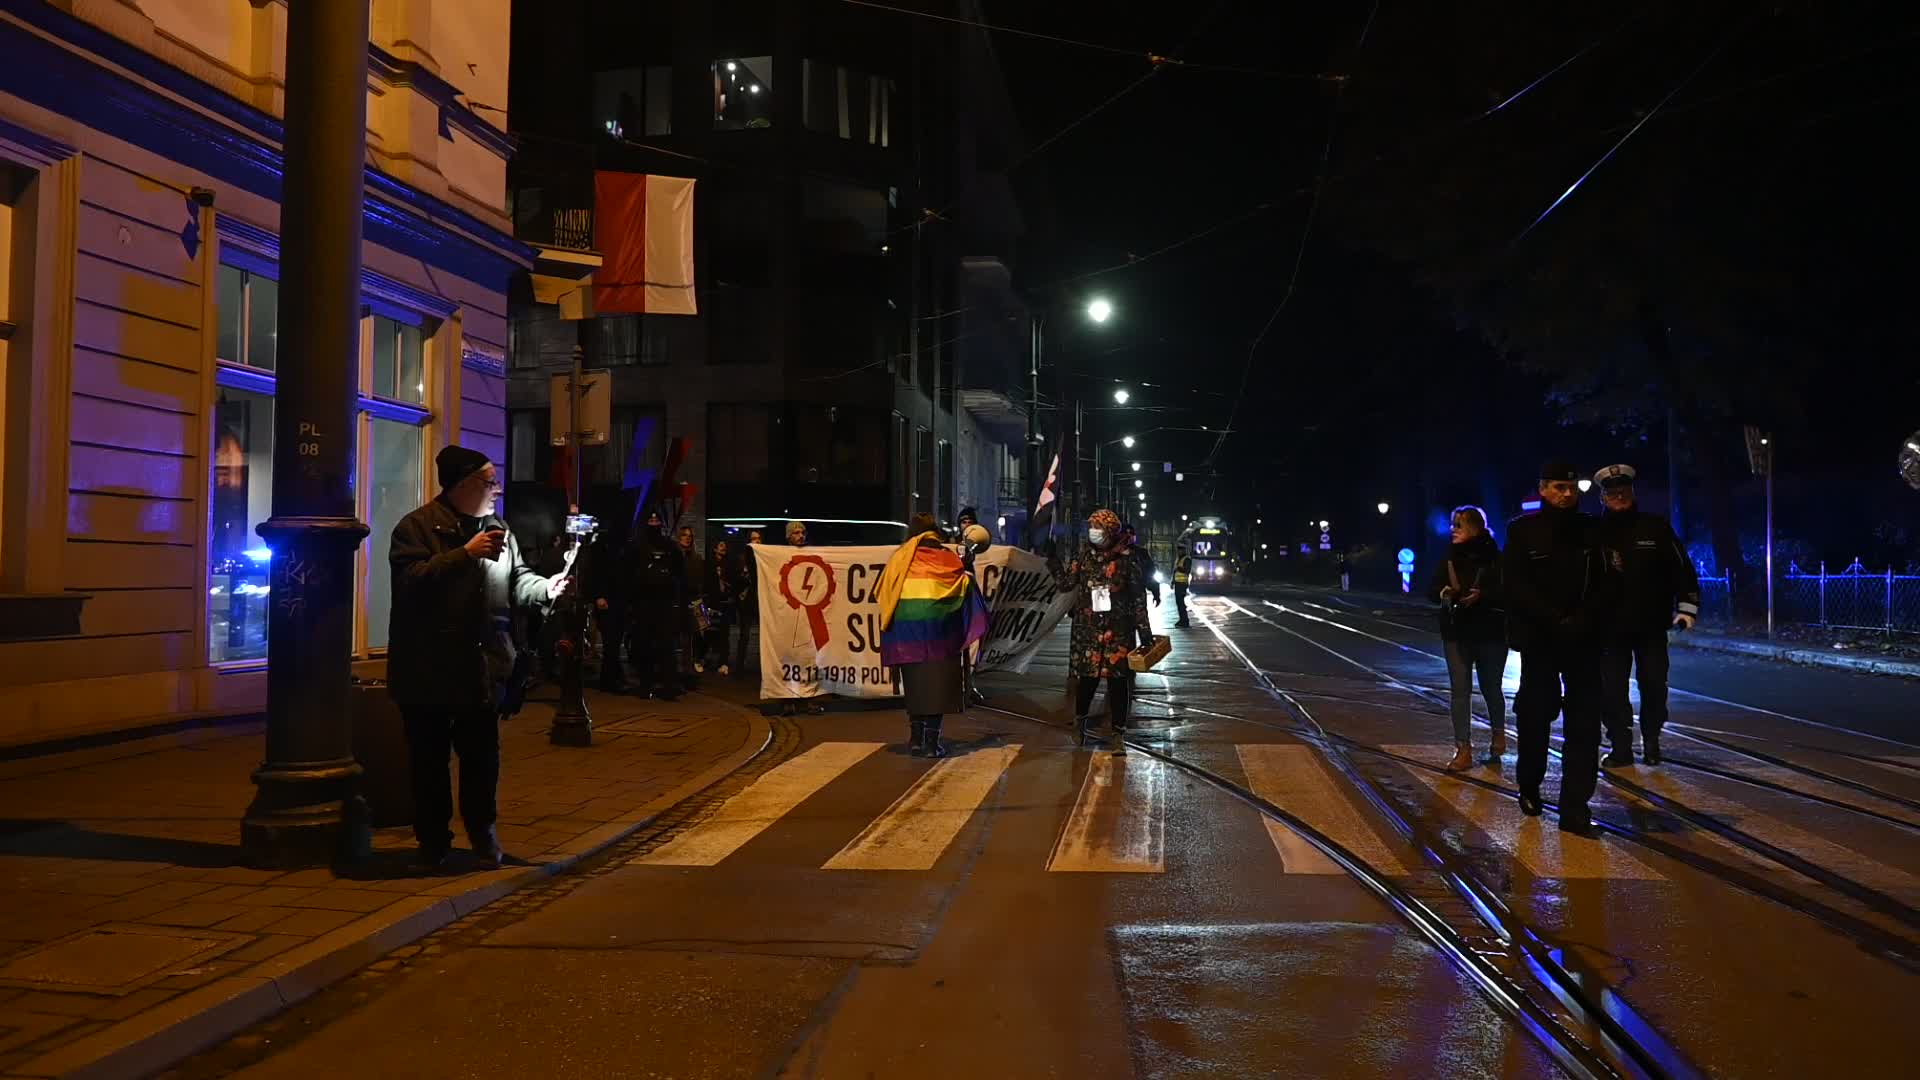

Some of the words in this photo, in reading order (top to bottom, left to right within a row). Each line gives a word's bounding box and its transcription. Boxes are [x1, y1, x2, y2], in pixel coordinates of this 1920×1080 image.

[299, 423, 321, 437] PL
[299, 442, 319, 456] 08
[847, 563, 887, 604] CZ
[847, 612, 881, 653] SU
